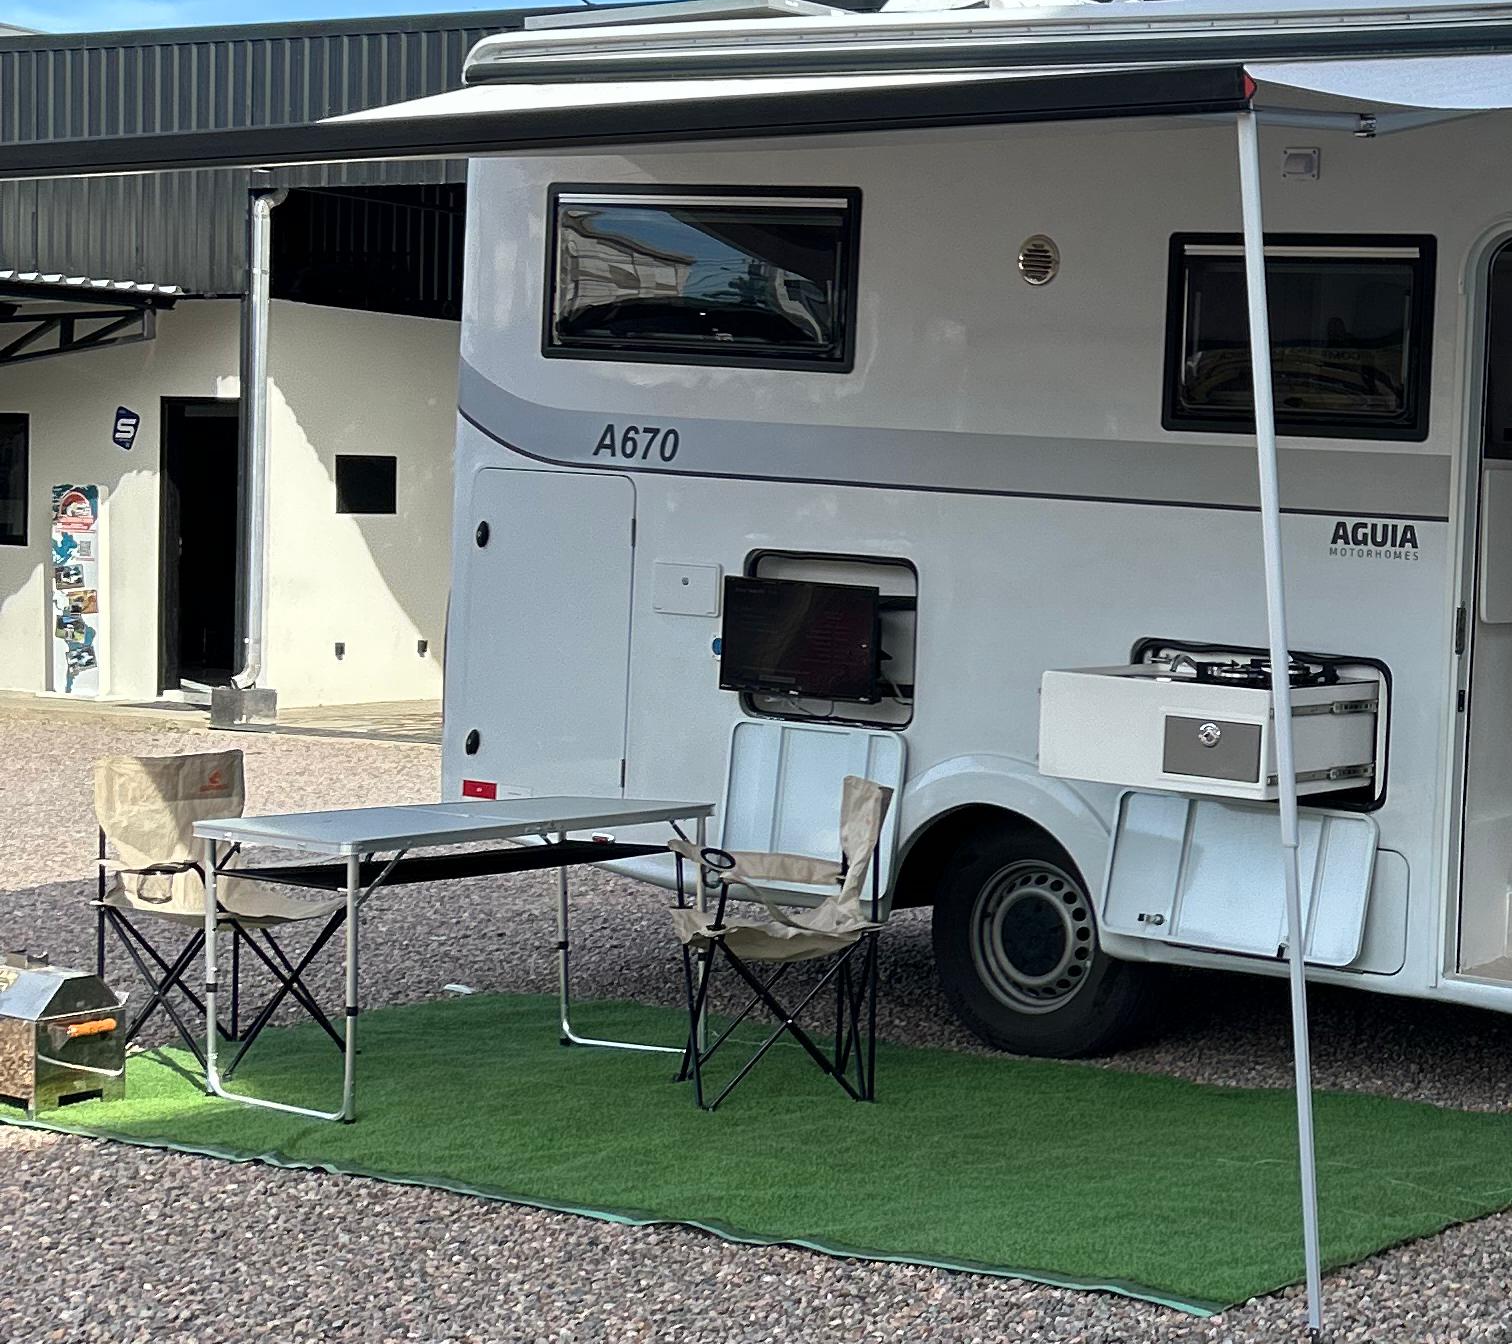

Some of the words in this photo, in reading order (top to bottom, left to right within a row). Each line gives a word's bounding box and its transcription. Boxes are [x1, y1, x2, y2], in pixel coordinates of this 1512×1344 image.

[592, 423, 680, 462] A670
[1330, 521, 1419, 549] AGUIA
[1329, 547, 1419, 561] MOTORHOMES
